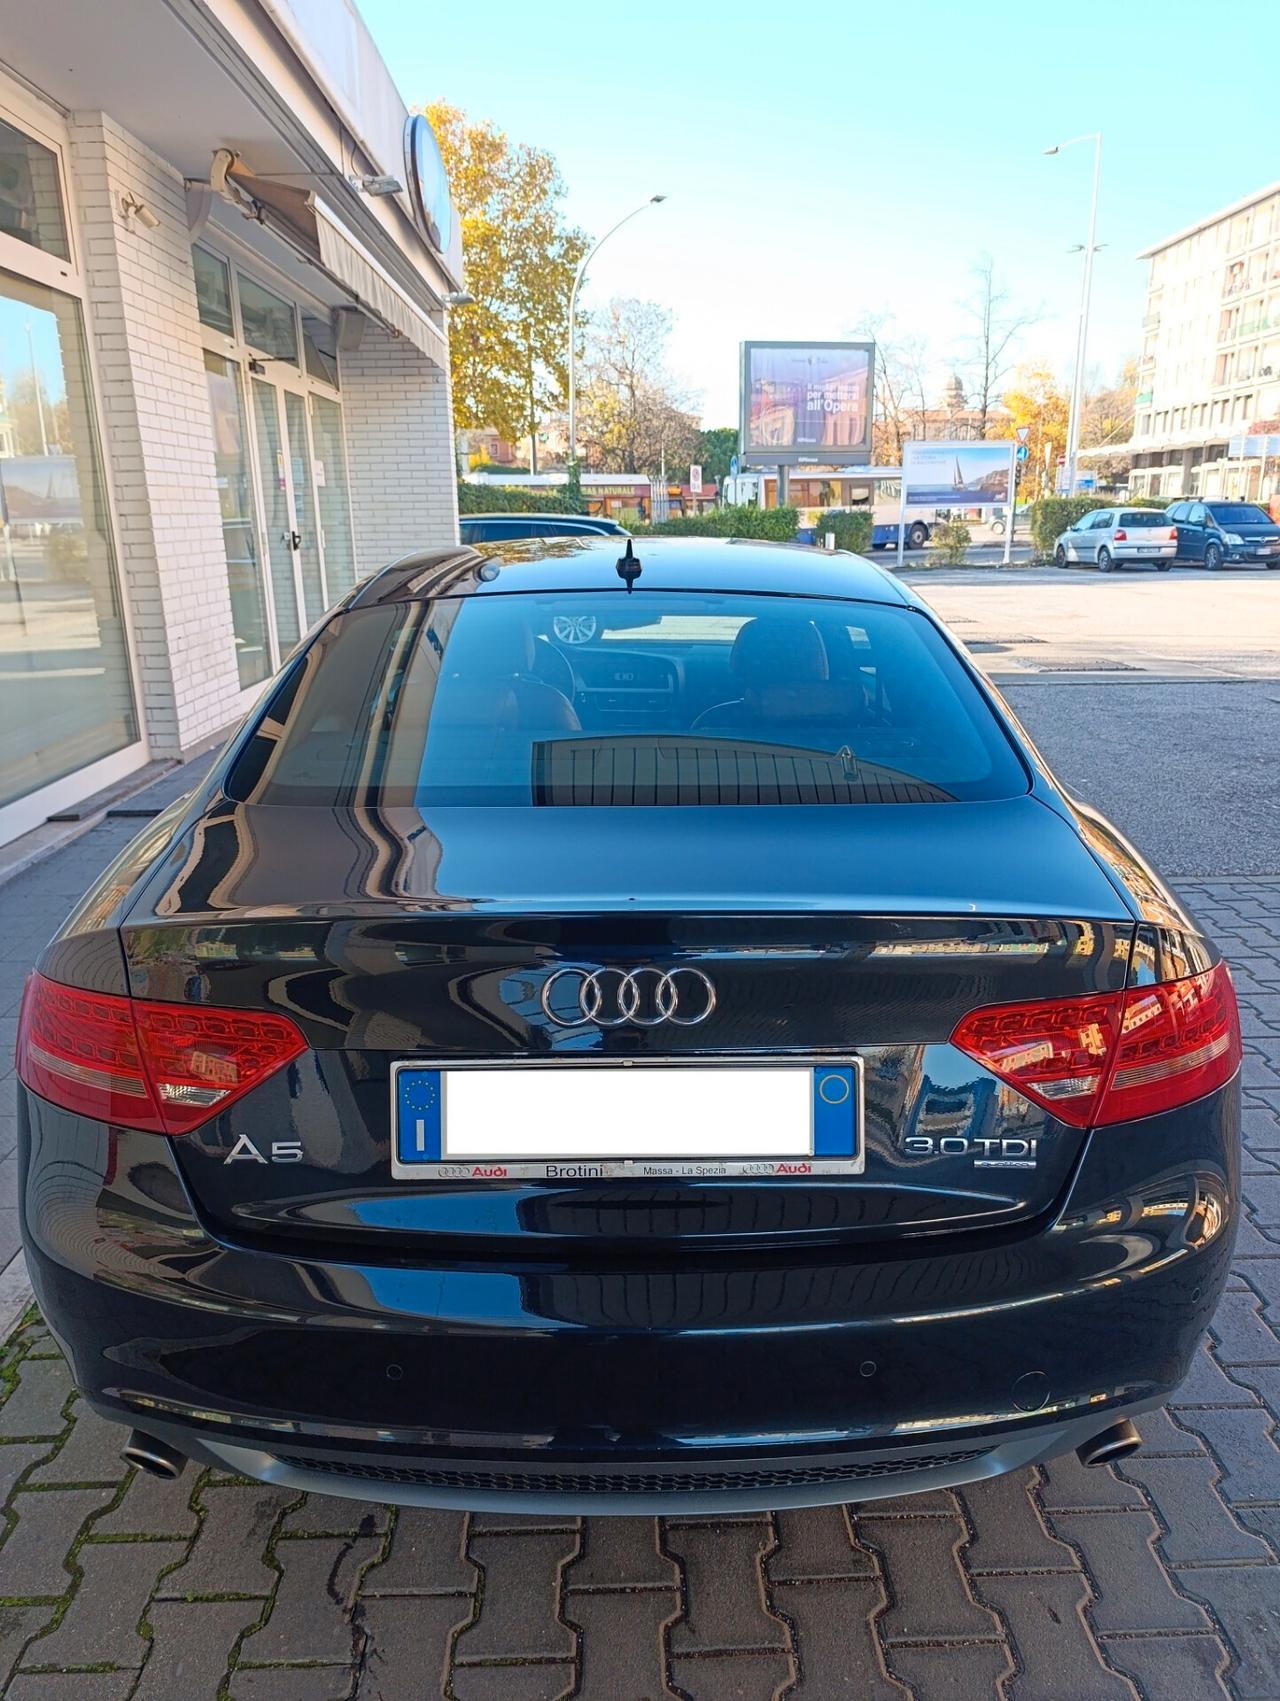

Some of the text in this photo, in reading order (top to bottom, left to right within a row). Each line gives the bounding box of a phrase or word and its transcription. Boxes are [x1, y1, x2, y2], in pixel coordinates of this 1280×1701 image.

[807, 392, 821, 400] per
[807, 399, 859, 413] all'Opera
[416, 1119, 425, 1151] I
[223, 1134, 304, 1164] A5
[973, 1138, 1037, 1157] TDI
[472, 1165, 604, 1178] Audi Brotini
[643, 1166, 673, 1176] Massa
[681, 1166, 693, 1175] La
[695, 1165, 727, 1176] Spezia
[776, 1163, 812, 1174] Audi
